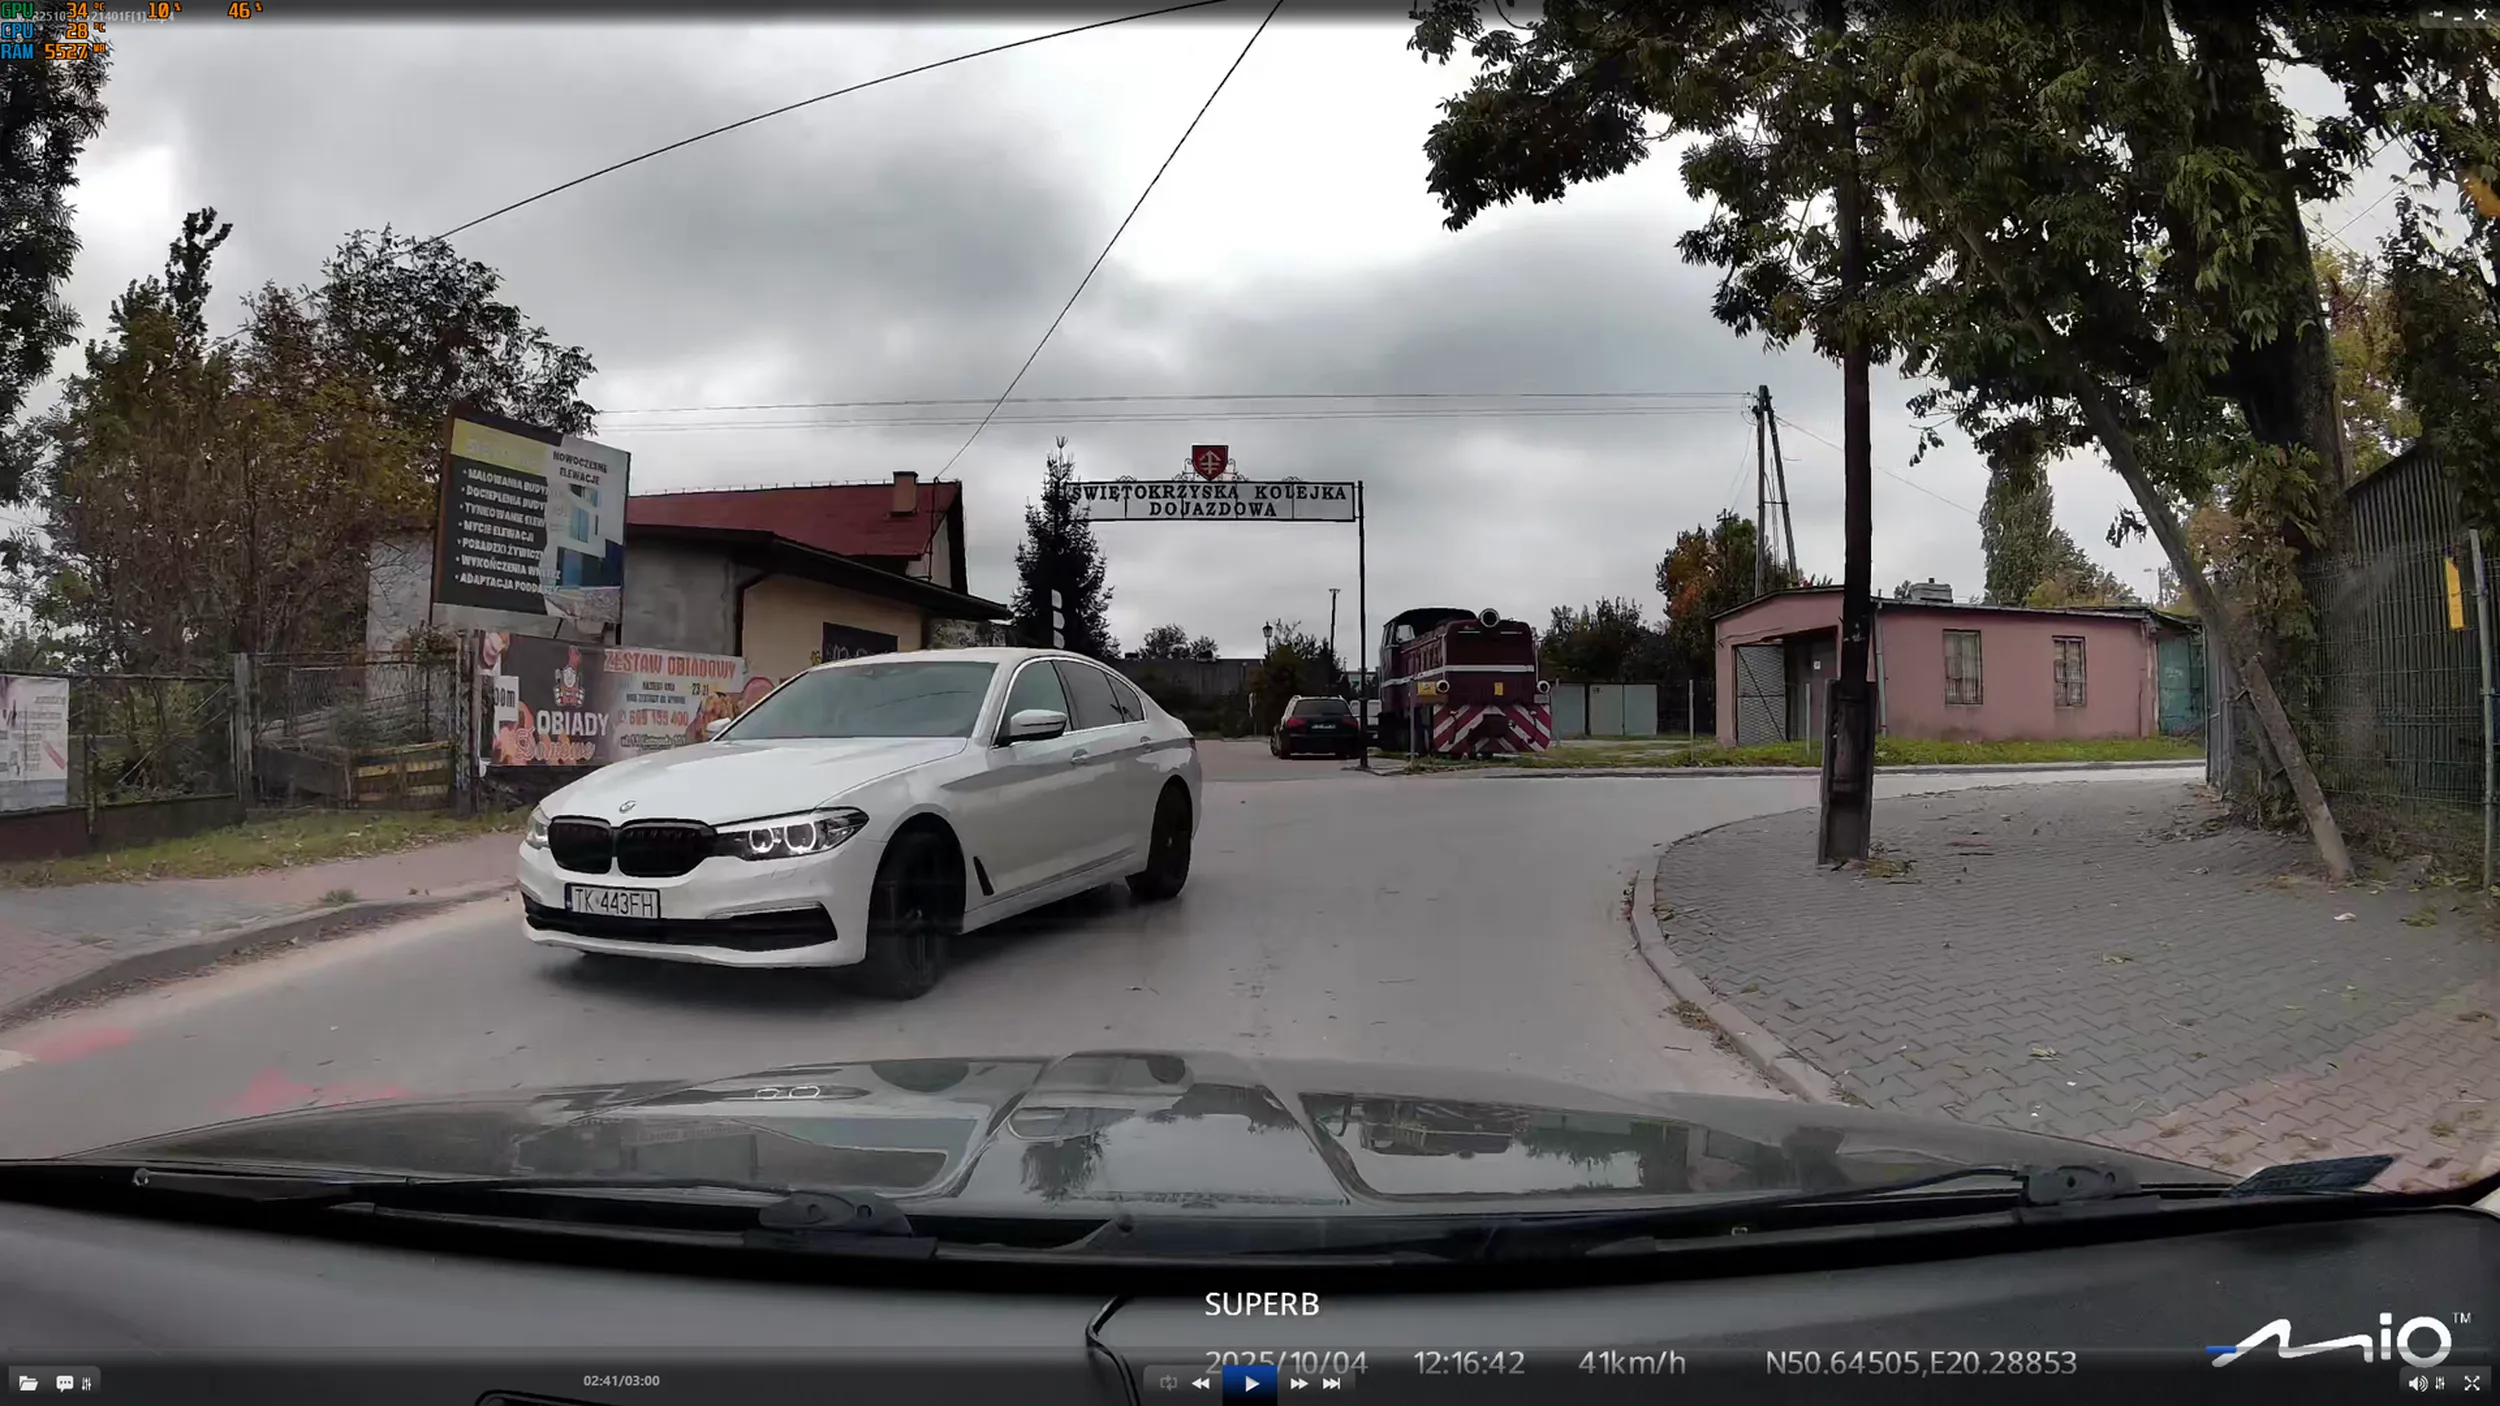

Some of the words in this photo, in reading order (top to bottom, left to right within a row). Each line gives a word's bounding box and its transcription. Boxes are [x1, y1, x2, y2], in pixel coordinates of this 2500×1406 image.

[1254, 485, 1346, 500] KOLEJKA
[1149, 502, 1277, 516] DOJAZDOWA
[464, 520, 492, 534] MYCIE
[460, 572, 513, 589] ADAPTACJA
[605, 651, 662, 674] ZESTAW
[667, 656, 736, 681] OBIADOWY
[537, 709, 609, 737] OBIADY
[575, 888, 594, 912] TK
[600, 891, 653, 917] 443FH
